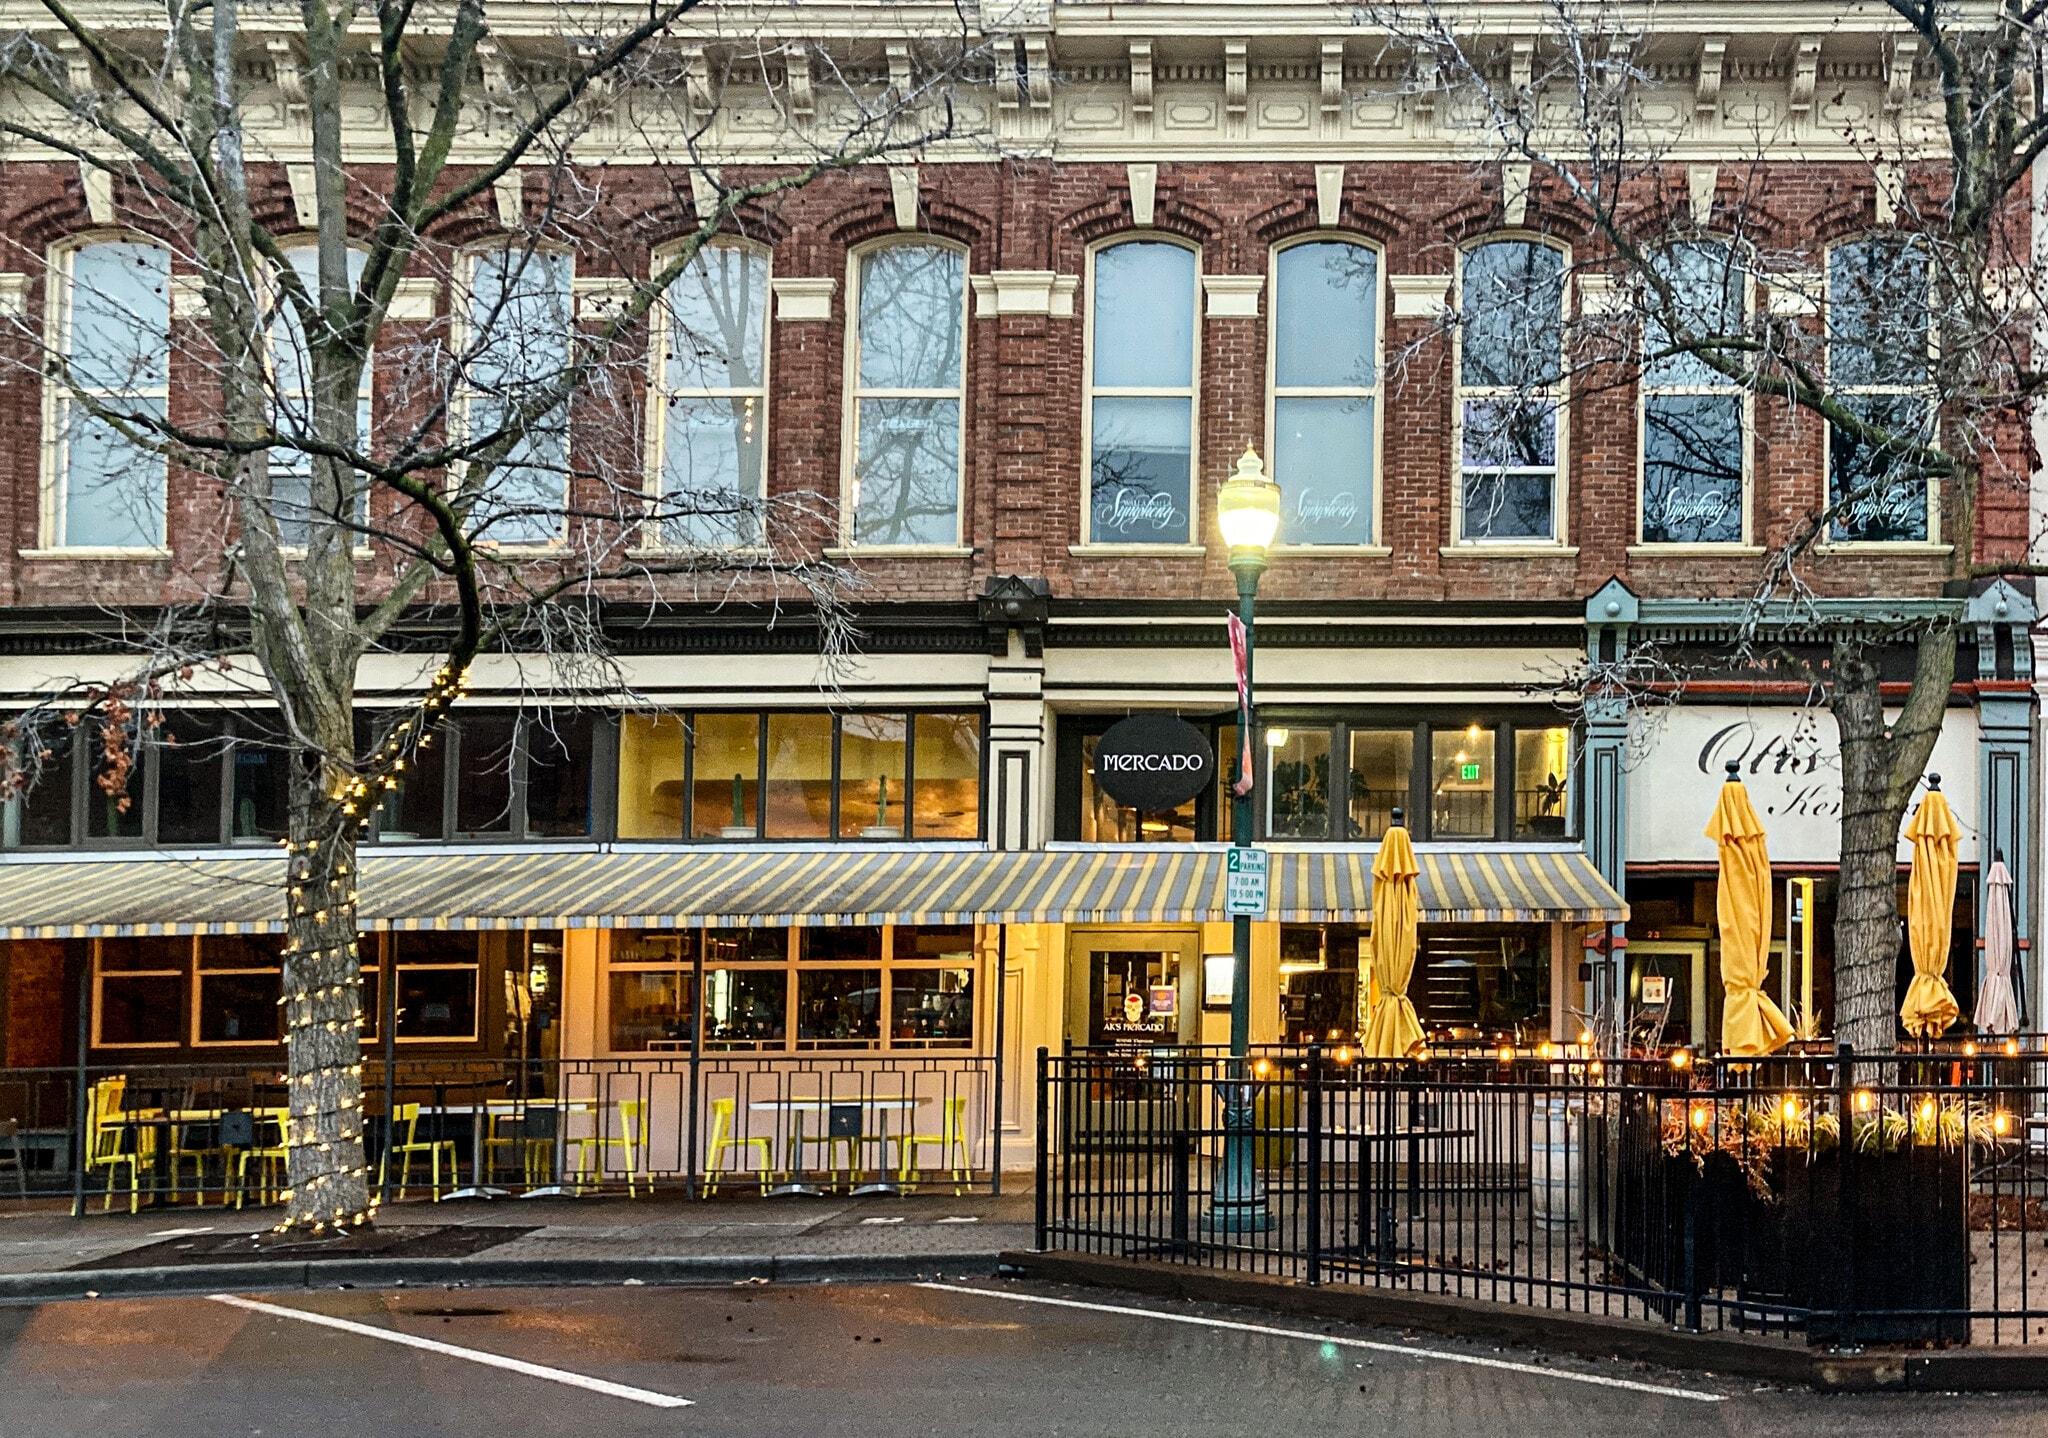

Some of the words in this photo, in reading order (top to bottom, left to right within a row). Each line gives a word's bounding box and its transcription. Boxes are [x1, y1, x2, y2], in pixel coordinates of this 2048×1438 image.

[1099, 488, 1182, 531] Symphony
[1293, 488, 1359, 530] Symphony
[1658, 487, 1732, 531] Symphony
[1462, 765, 1479, 779] EXIT
[1229, 853, 1238, 869] 2
[1246, 852, 1258, 861] HR
[1241, 863, 1265, 871] PARKING
[1251, 878, 1259, 886] AM
[1230, 889, 1237, 898] TO
[1255, 890, 1263, 899] PM
